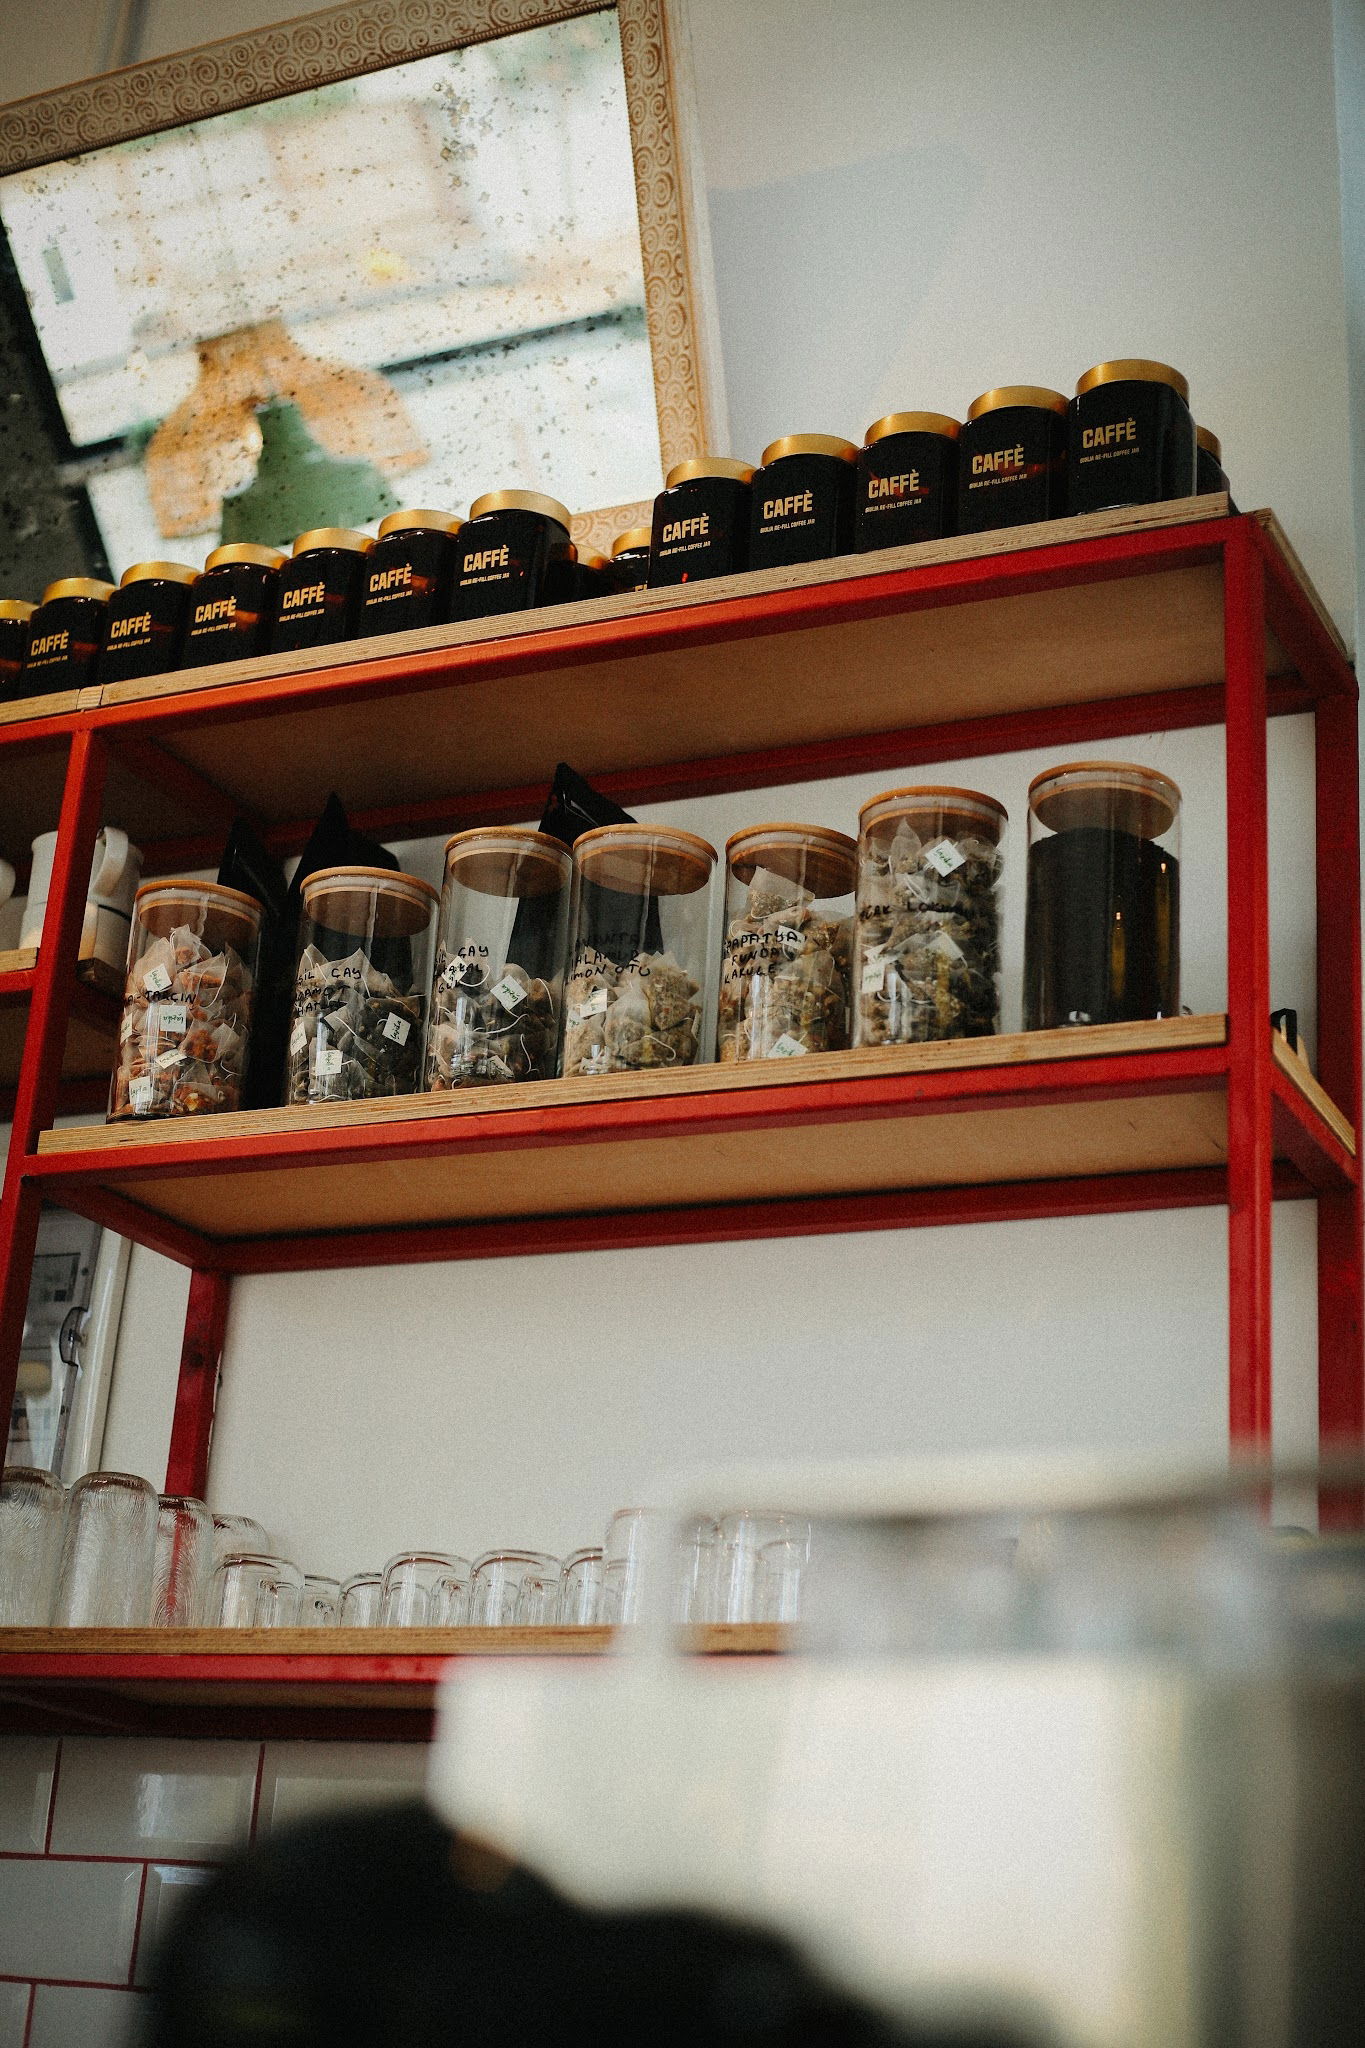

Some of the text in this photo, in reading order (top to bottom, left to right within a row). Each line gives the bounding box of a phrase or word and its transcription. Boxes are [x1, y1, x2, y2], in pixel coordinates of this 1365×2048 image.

[1082, 417, 1137, 449] CAFFÈ
[972, 444, 1025, 475] CAFFÈ
[868, 469, 920, 499] CAFFÈ
[1001, 474, 1018, 484] COFFEE
[763, 490, 814, 520] CAFFÈ
[896, 499, 913, 509] COFFEE
[662, 513, 710, 543] CAFFÈ
[790, 519, 807, 529] COFFEE
[463, 544, 510, 573] CAFFÈ
[369, 562, 413, 592] CAFFÈ
[194, 596, 237, 623] CAFFÈ
[282, 582, 326, 609] CAFFÈ
[110, 611, 152, 639] CAFFÈ
[30, 630, 70, 656] CAFFÈ
